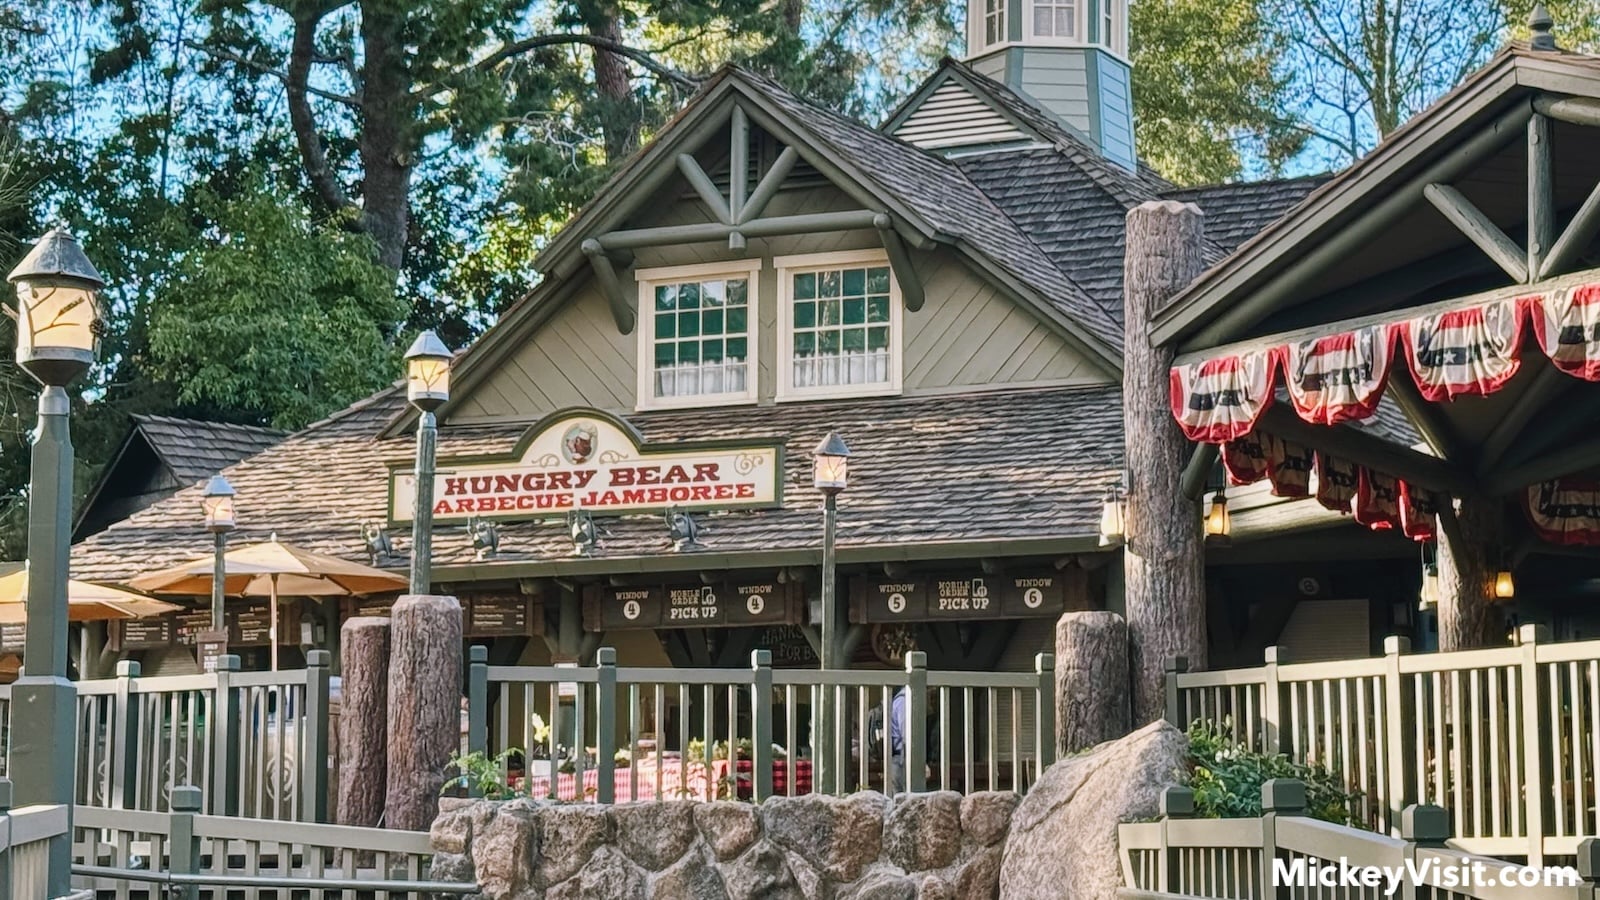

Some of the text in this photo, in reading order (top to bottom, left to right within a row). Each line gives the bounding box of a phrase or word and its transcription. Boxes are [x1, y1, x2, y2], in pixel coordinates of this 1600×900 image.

[444, 463, 720, 496] HUNGRY BEAR
[433, 483, 755, 514] ARBECUE JAMBOREE
[938, 581, 970, 590] MOBILE
[1014, 578, 1052, 588] WINDOW
[737, 585, 773, 595] WINDOW
[878, 584, 915, 593] WINDOW
[939, 588, 969, 597] ORDER
[615, 591, 649, 601] WINDOW
[670, 590, 700, 599] MOBILE
[671, 597, 699, 606] ORDER
[938, 597, 990, 610] PICK UP
[670, 606, 718, 619] PICK UP
